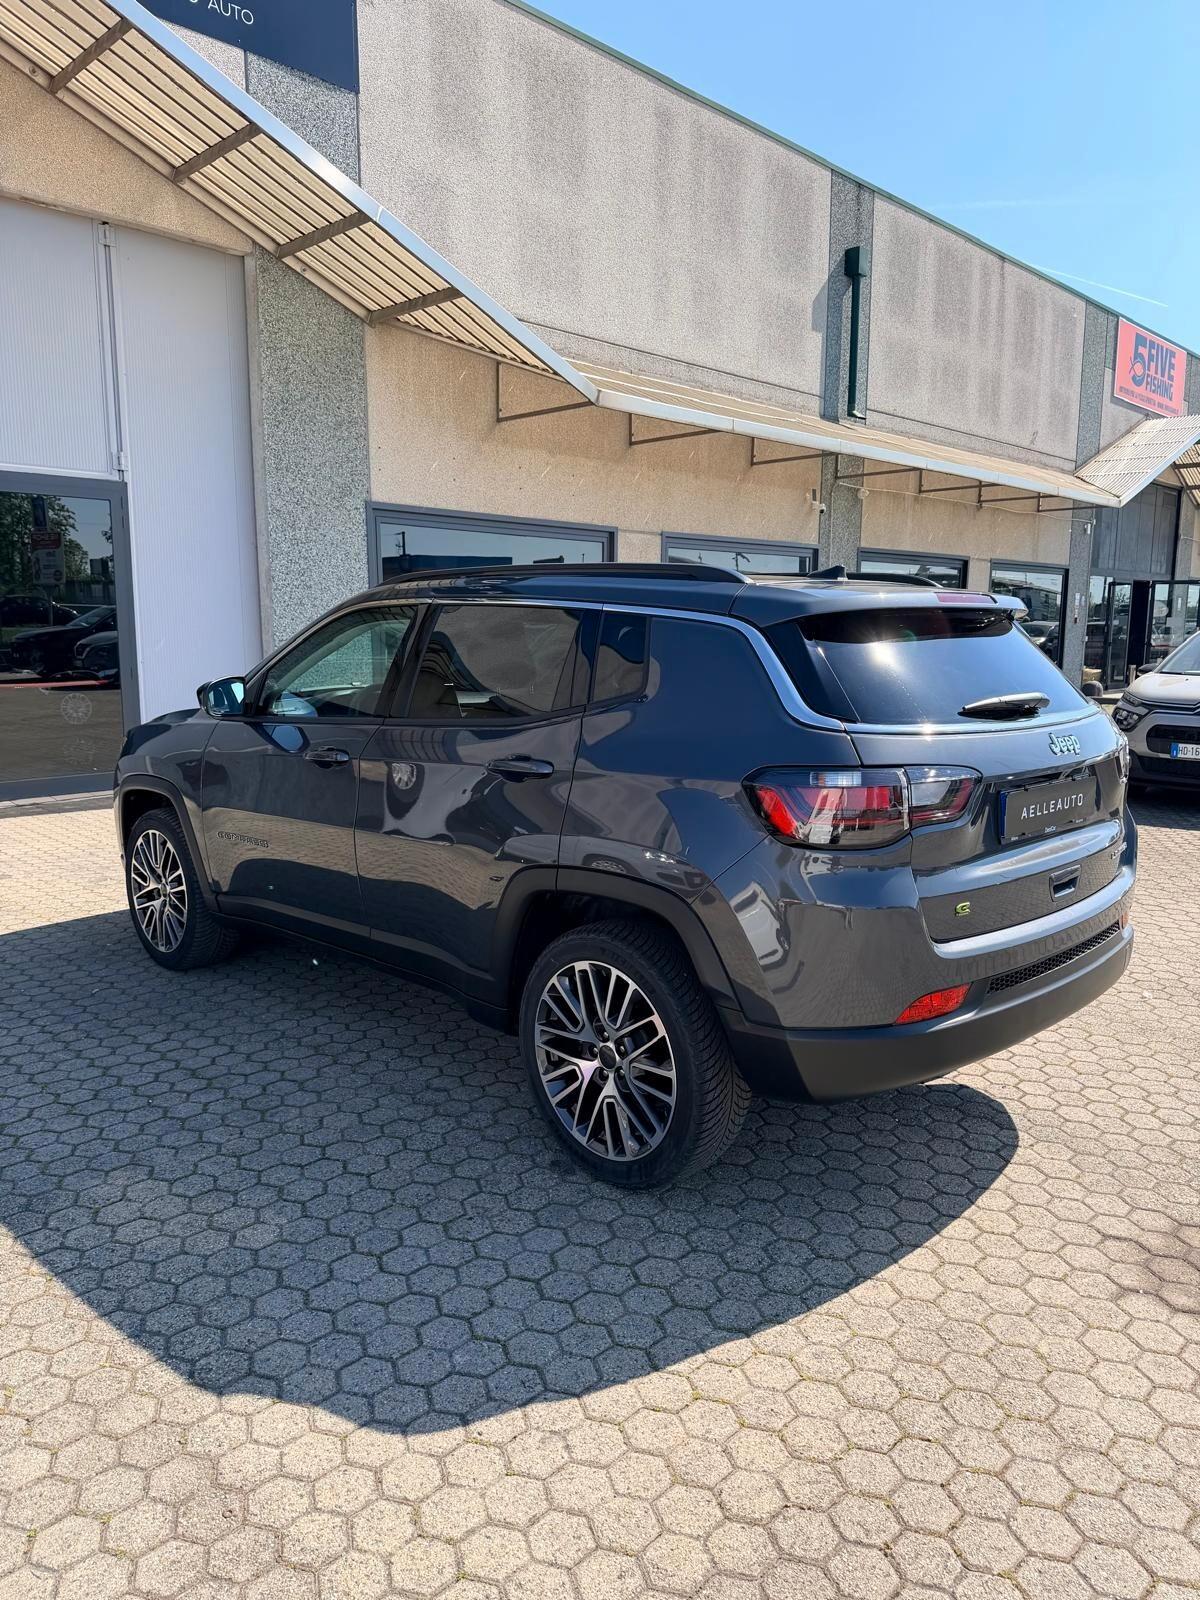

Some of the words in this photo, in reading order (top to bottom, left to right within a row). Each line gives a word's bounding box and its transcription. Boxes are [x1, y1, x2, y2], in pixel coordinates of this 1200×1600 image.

[207, 0, 254, 25] AUTO
[1147, 339, 1176, 382] FIVE
[1145, 373, 1174, 401] FISHING
[1048, 732, 1081, 755] Jeep
[1020, 793, 1084, 820] AELLEAUTO
